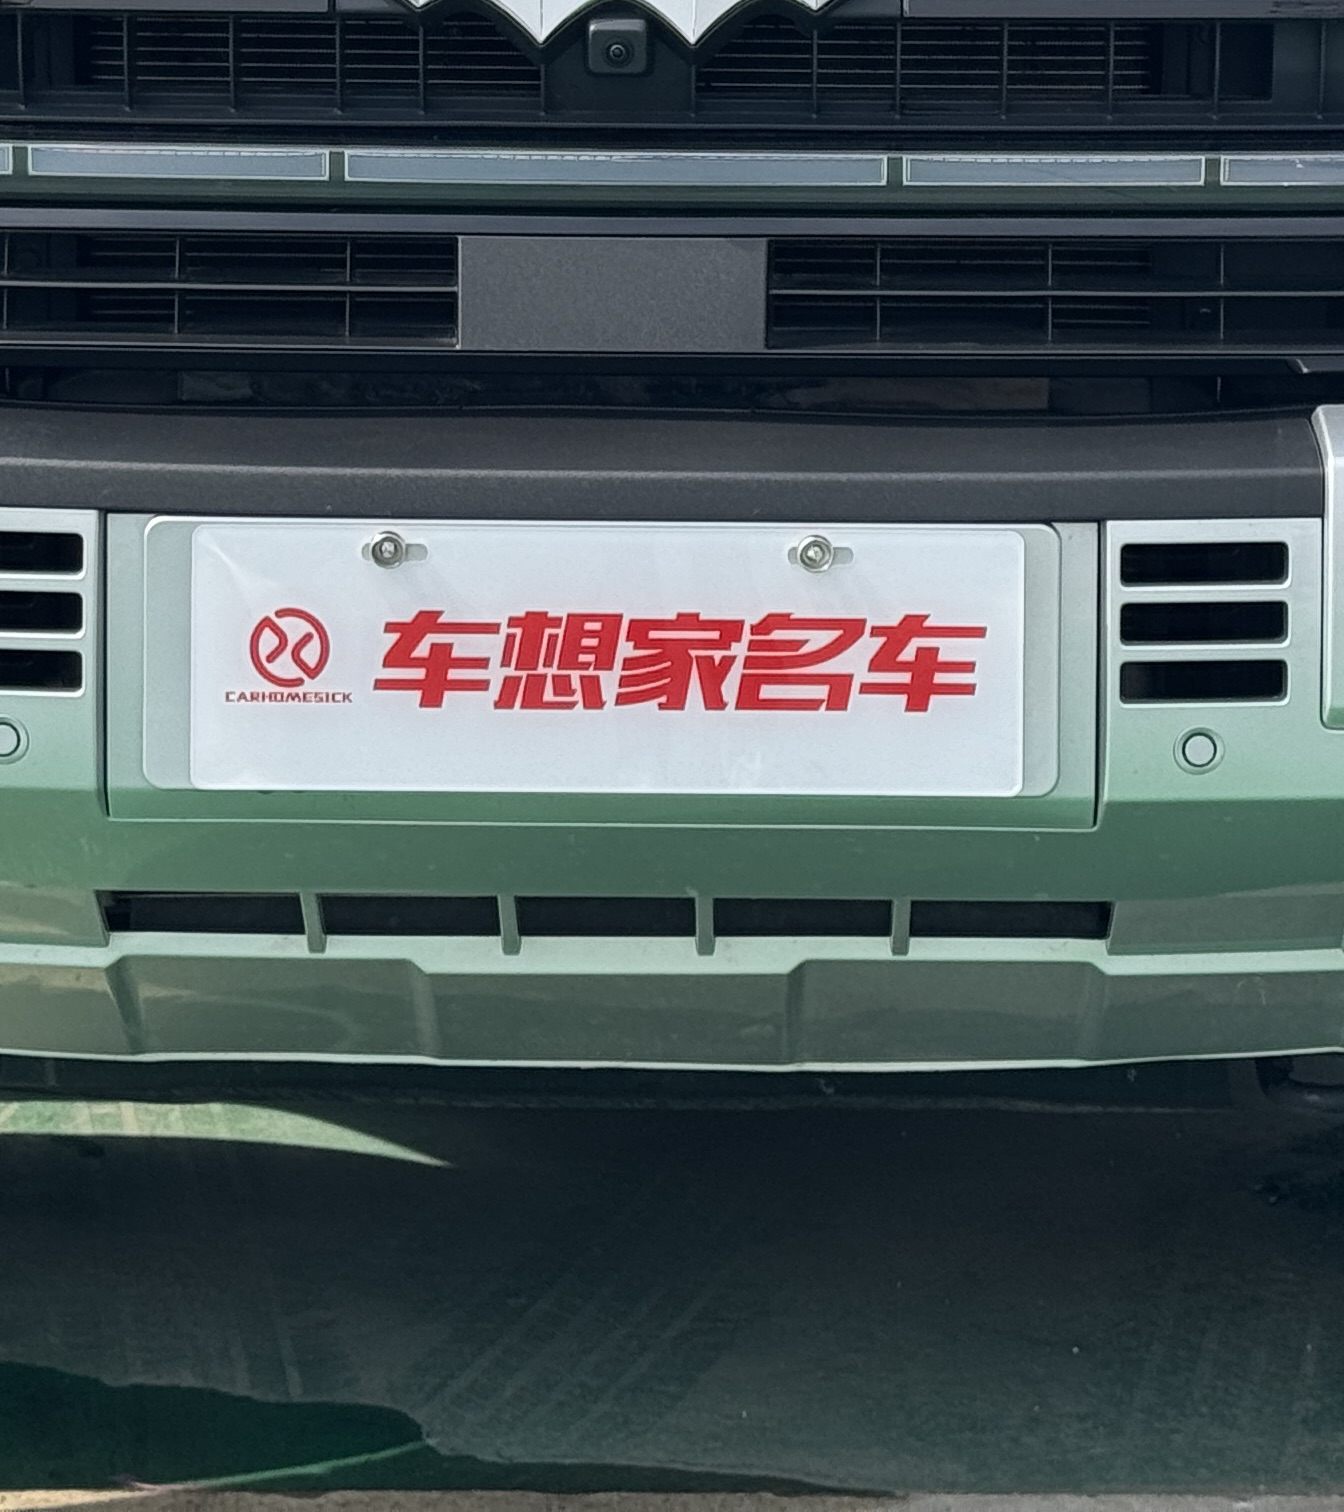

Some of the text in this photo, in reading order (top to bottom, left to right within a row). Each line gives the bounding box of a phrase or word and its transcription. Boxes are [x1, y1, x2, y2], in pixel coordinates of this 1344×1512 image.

[373, 609, 988, 713] 车想家名车
[224, 690, 354, 704] CARHOMESICK
